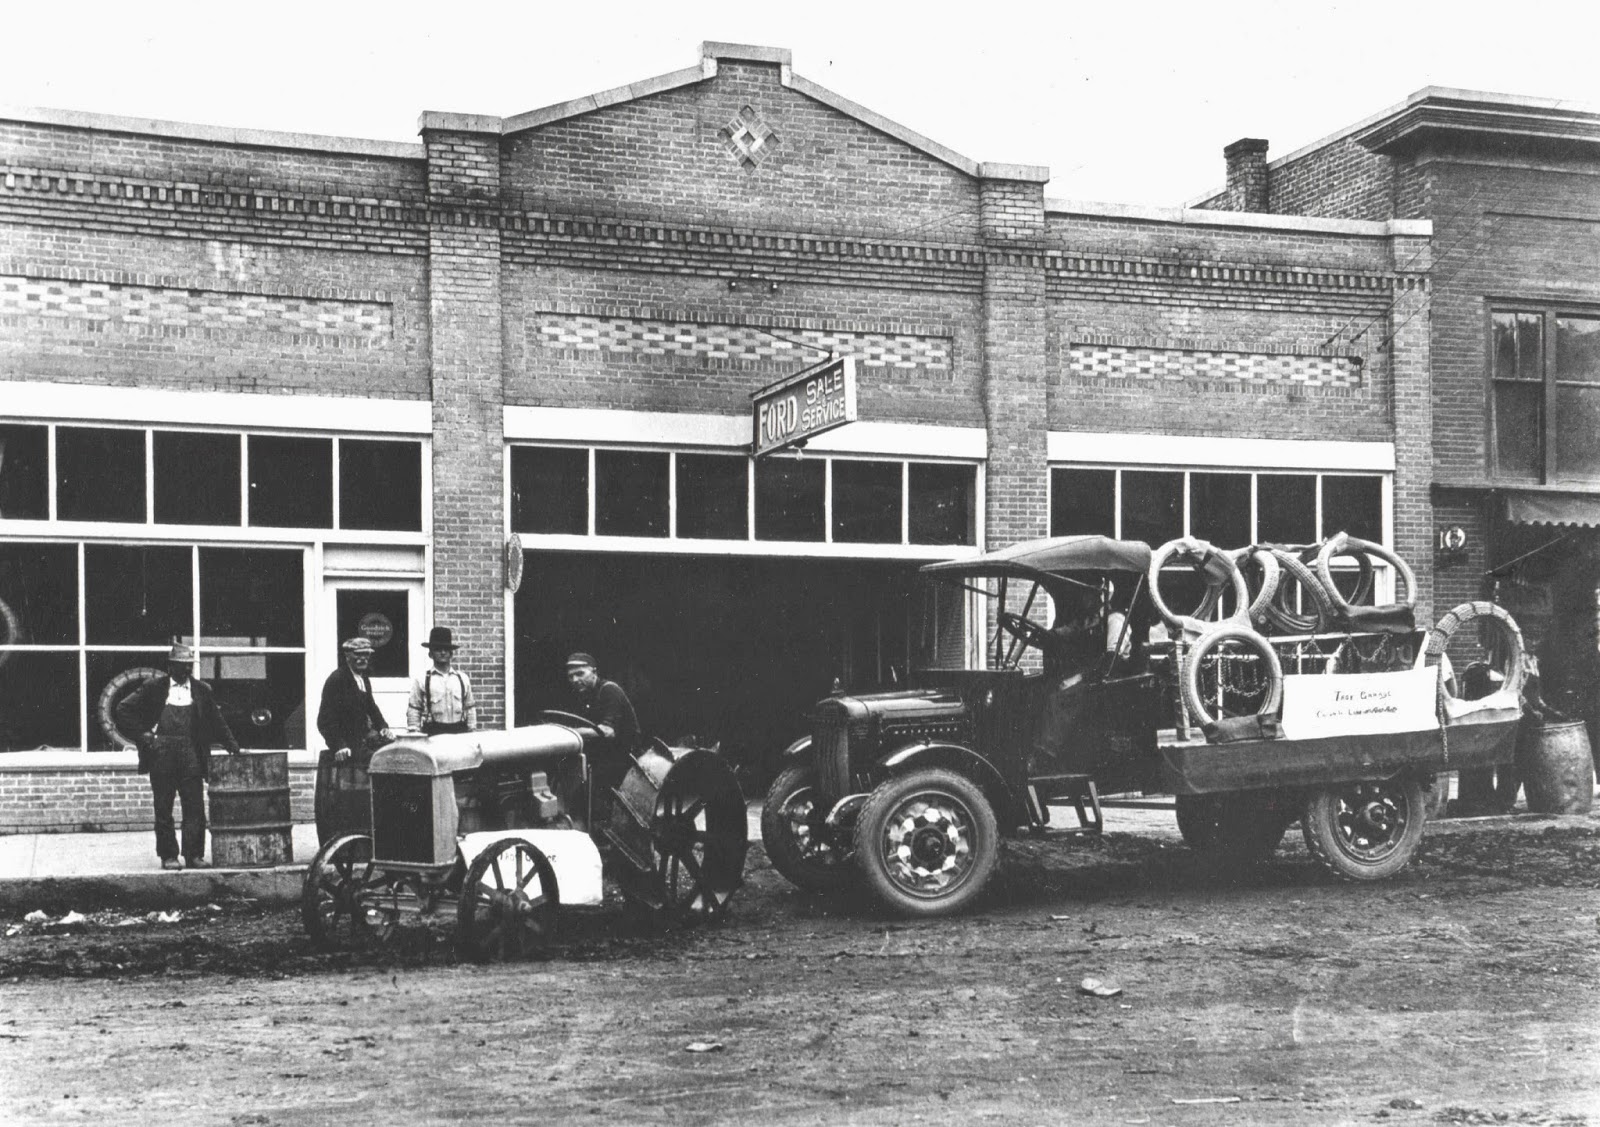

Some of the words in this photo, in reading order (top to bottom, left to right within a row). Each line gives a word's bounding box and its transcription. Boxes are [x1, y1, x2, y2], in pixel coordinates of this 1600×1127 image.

[806, 368, 843, 405] SALE
[759, 395, 798, 445] FORD
[801, 397, 845, 431] SERVICE
